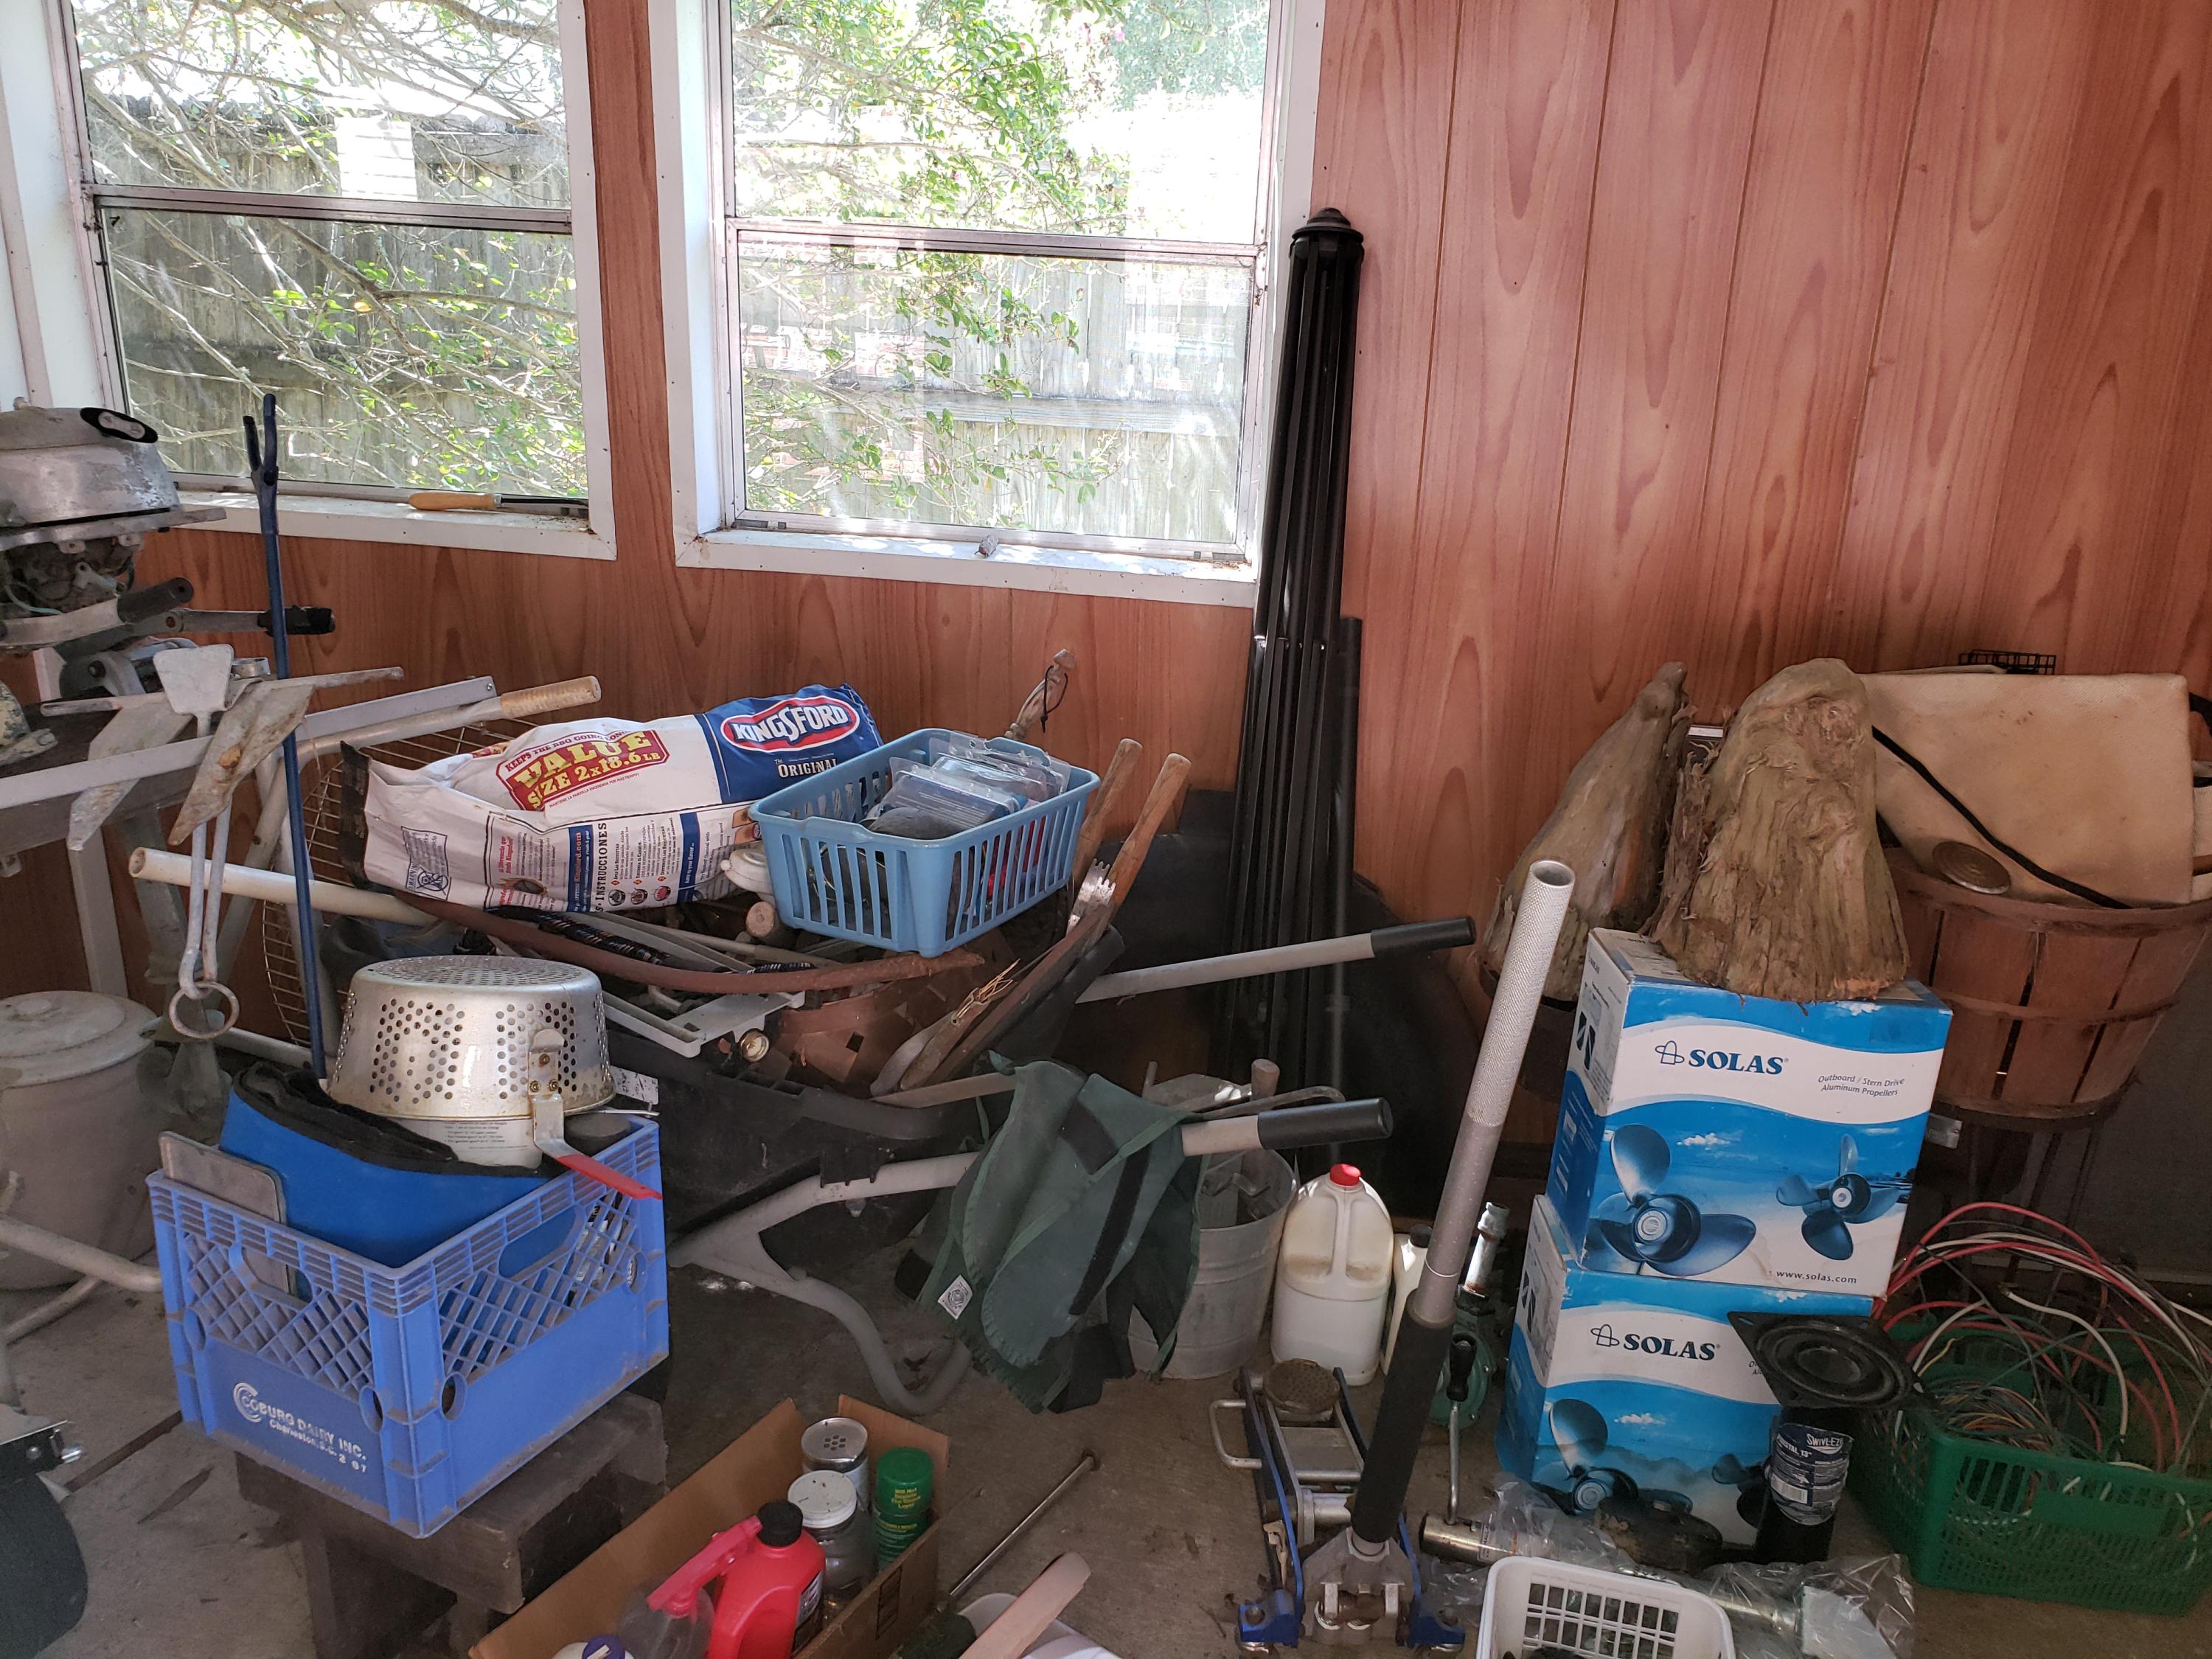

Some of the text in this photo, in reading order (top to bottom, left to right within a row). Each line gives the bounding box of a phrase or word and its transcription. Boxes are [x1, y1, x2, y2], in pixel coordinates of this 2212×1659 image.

[732, 704, 849, 742] KINGSFORD
[504, 752, 532, 772] KEEPS
[532, 742, 552, 755] THE
[514, 731, 653, 788] VALUE
[527, 772, 571, 809] SIZE
[595, 822, 608, 901] INSTRUCCIONES
[1688, 1049, 1784, 1075] SOLAS
[1818, 1074, 1856, 1083] Outboard
[1862, 1078, 1882, 1087] Stern
[1884, 1078, 1905, 1088] Drive
[1820, 1084, 1899, 1098] Aluminum Propellers
[1776, 1270, 1857, 1284] www.solas.com
[1623, 1333, 1716, 1361] SOLAS
[297, 1418, 335, 1445] DAIRY
[338, 1438, 367, 1461] INC.
